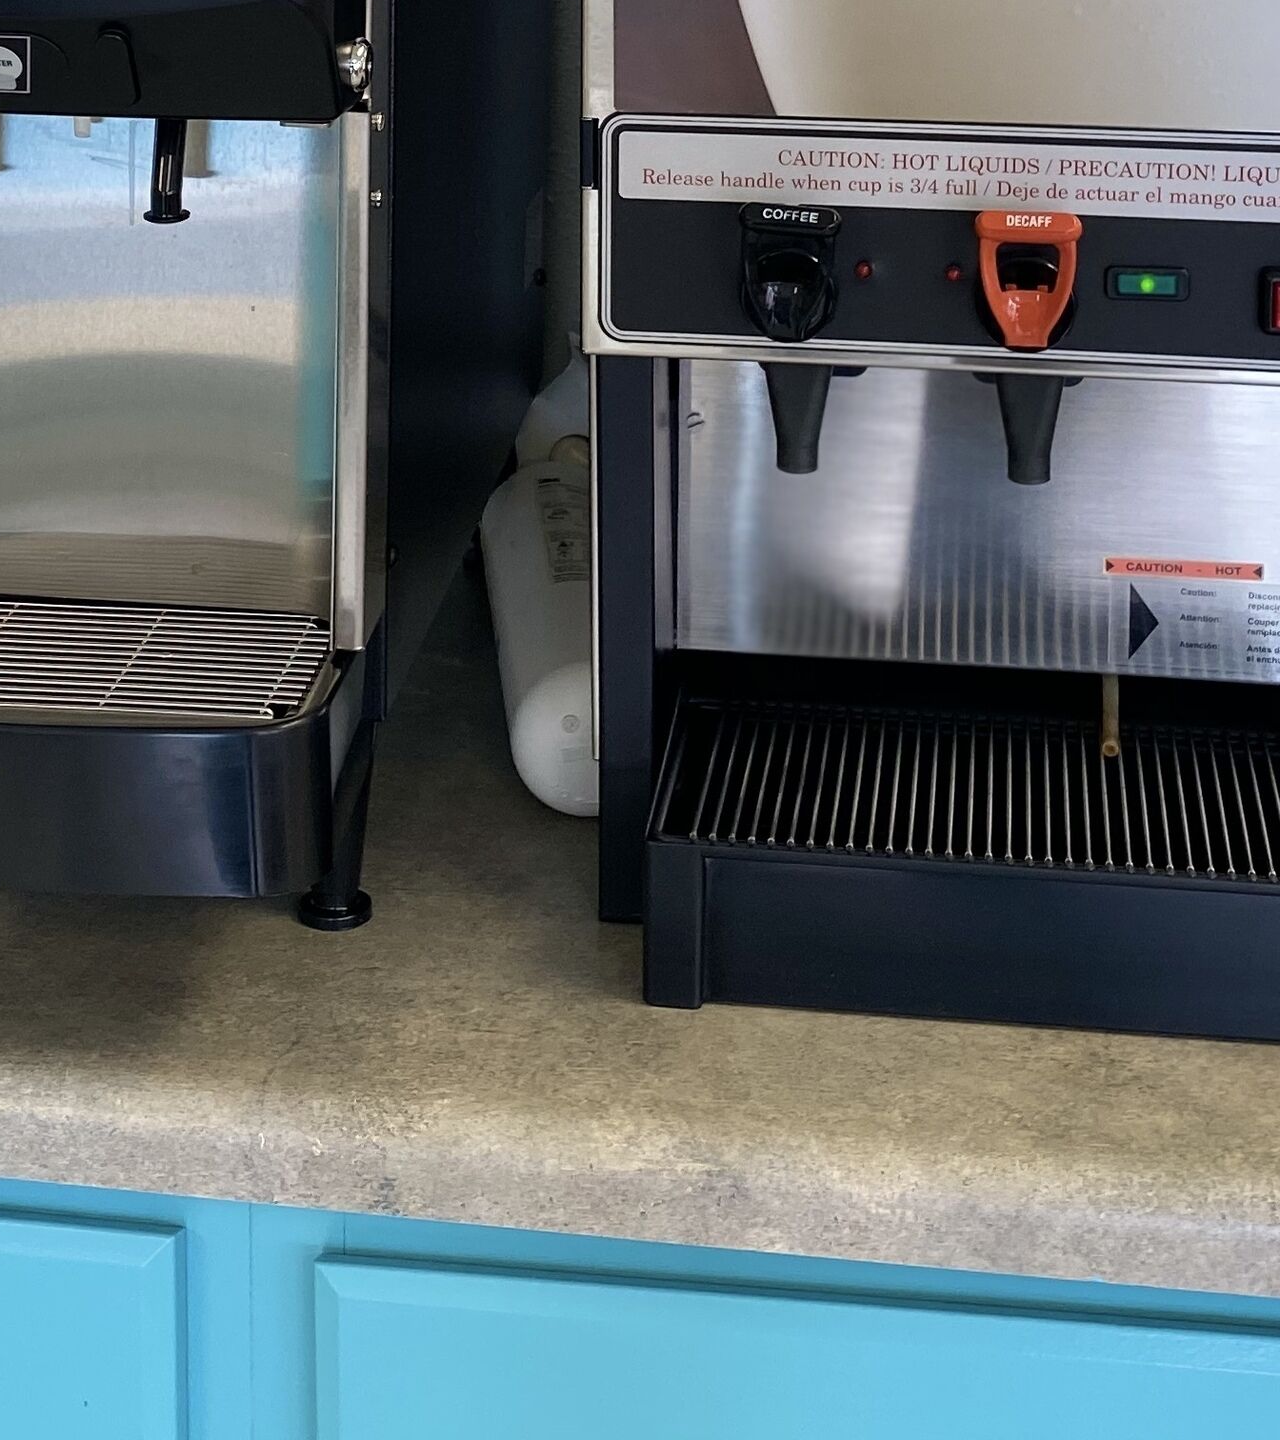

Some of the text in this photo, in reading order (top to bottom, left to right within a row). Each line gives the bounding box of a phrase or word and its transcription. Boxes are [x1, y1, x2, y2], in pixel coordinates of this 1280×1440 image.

[778, 150, 885, 169] CAUTION:
[892, 153, 939, 171] HOT
[945, 156, 1040, 176] LIQUIDS
[1045, 158, 1053, 175] /
[1059, 159, 1216, 182] PRECAUTION!
[643, 168, 714, 186] Release
[720, 171, 785, 189] handle
[791, 174, 841, 191] when
[848, 179, 882, 196] cup
[888, 177, 904, 193] is
[910, 178, 938, 195] 3/4
[945, 179, 977, 196] full
[983, 180, 990, 196] /
[996, 180, 1040, 201] Deje
[1046, 183, 1068, 199] de
[1075, 186, 1139, 202] actuar
[1145, 187, 1162, 203] el
[1169, 191, 1236, 209] mango
[762, 207, 820, 224] COFFEE
[1005, 213, 1053, 229] DECAFF
[1125, 561, 1184, 574] CAUTION
[1215, 565, 1243, 577] HOT
[1248, 617, 1279, 627] Couper
[1246, 645, 1272, 653] Antes
